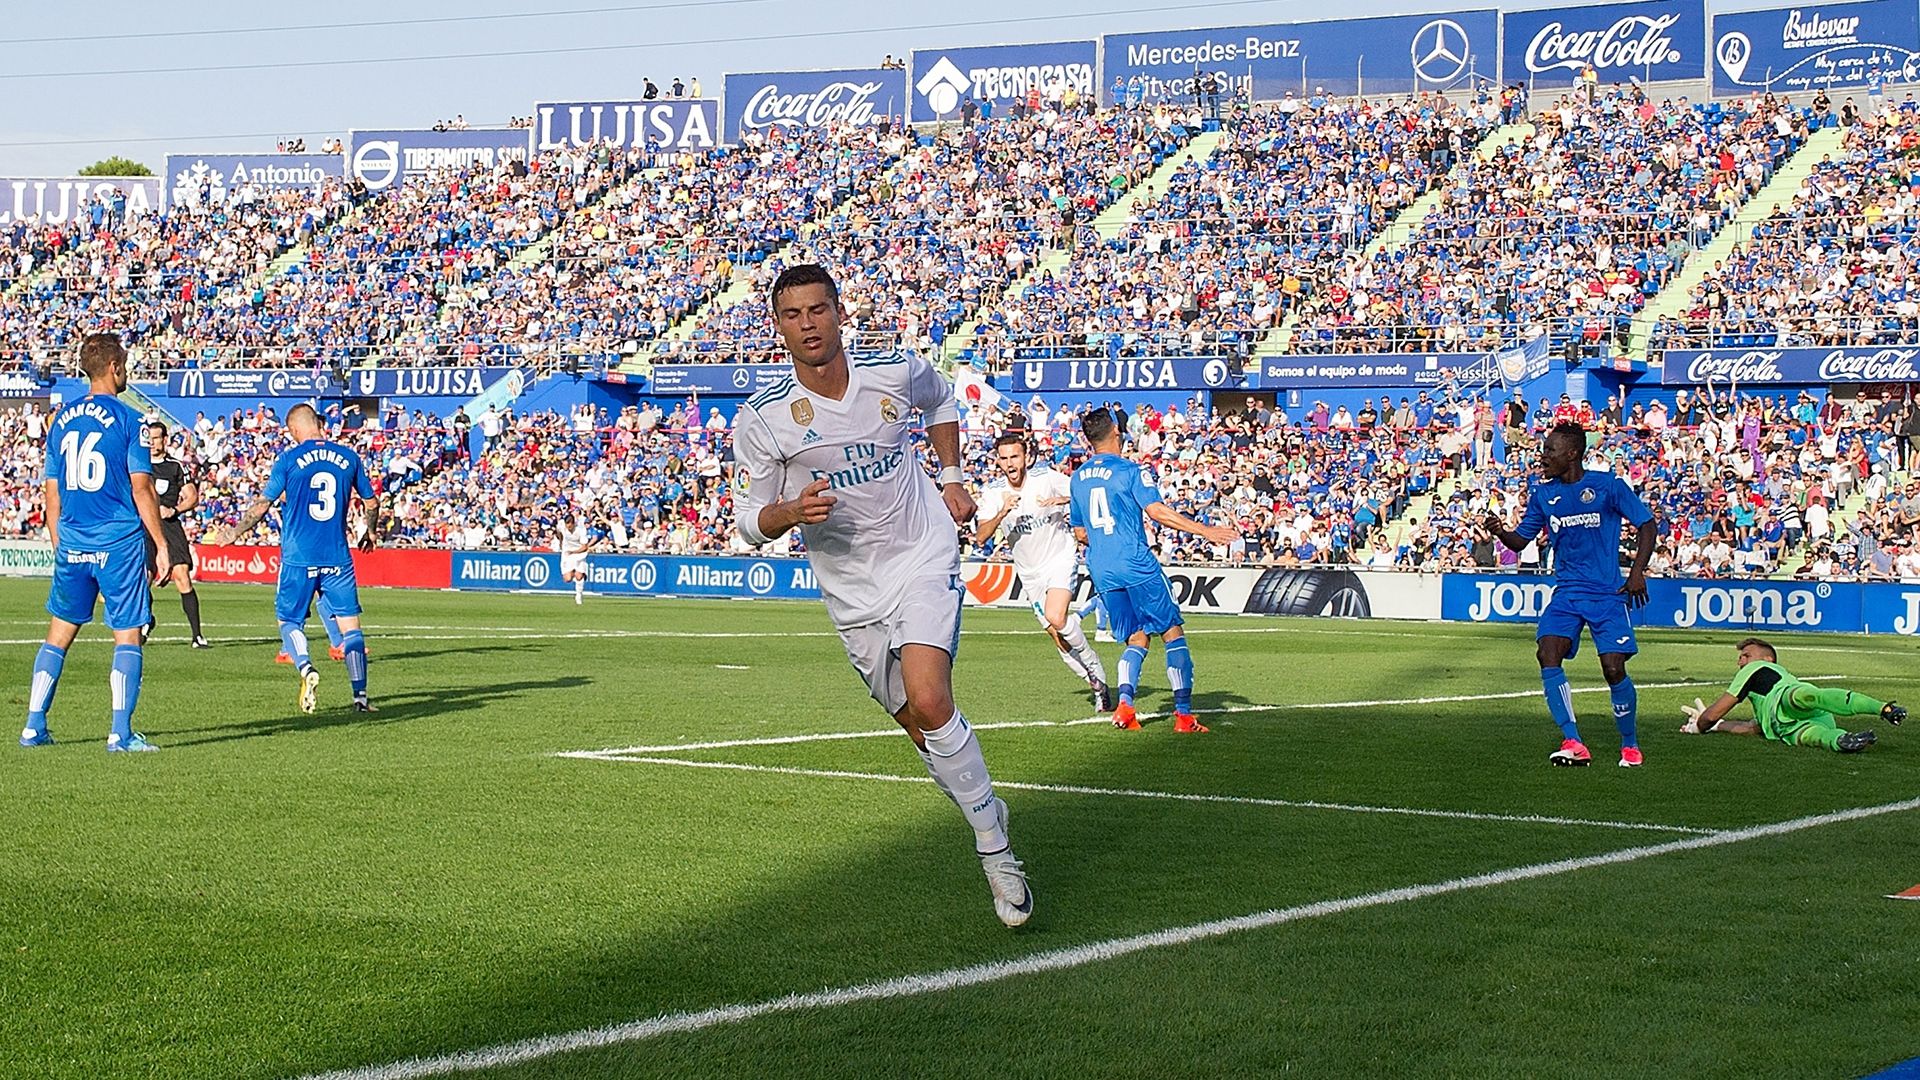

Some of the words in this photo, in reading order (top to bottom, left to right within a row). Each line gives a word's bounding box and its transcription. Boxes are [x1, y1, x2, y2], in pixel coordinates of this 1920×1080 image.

[1783, 10, 1859, 40] Bulevar
[1127, 37, 1300, 67] Mercedes-Benz
[1814, 55, 1835, 74] Muy
[1867, 51, 1880, 65] de
[969, 63, 1092, 99] TECNOCASA
[1786, 78, 1810, 90] muy
[1845, 68, 1863, 81] del
[538, 103, 714, 150] LUJISA
[230, 161, 325, 184] Antonio
[395, 370, 484, 395] LUJISA
[1069, 361, 1178, 389] LUJISA
[1268, 366, 1304, 377] Somos
[1306, 365, 1317, 377] el
[1319, 365, 1356, 379] equipo
[1358, 364, 1373, 376] de
[1375, 364, 1407, 376] moda
[60, 430, 106, 493] 16
[296, 449, 350, 471] ANTUNES
[844, 443, 875, 462] Fly
[1079, 467, 1113, 482] BRUNO
[309, 471, 337, 522] 3
[1089, 486, 1116, 536] 4
[1, 548, 53, 568] TECNOCAS
[201, 555, 246, 576] LaLiga
[461, 559, 521, 582] Allianz
[676, 564, 744, 588] Allianz
